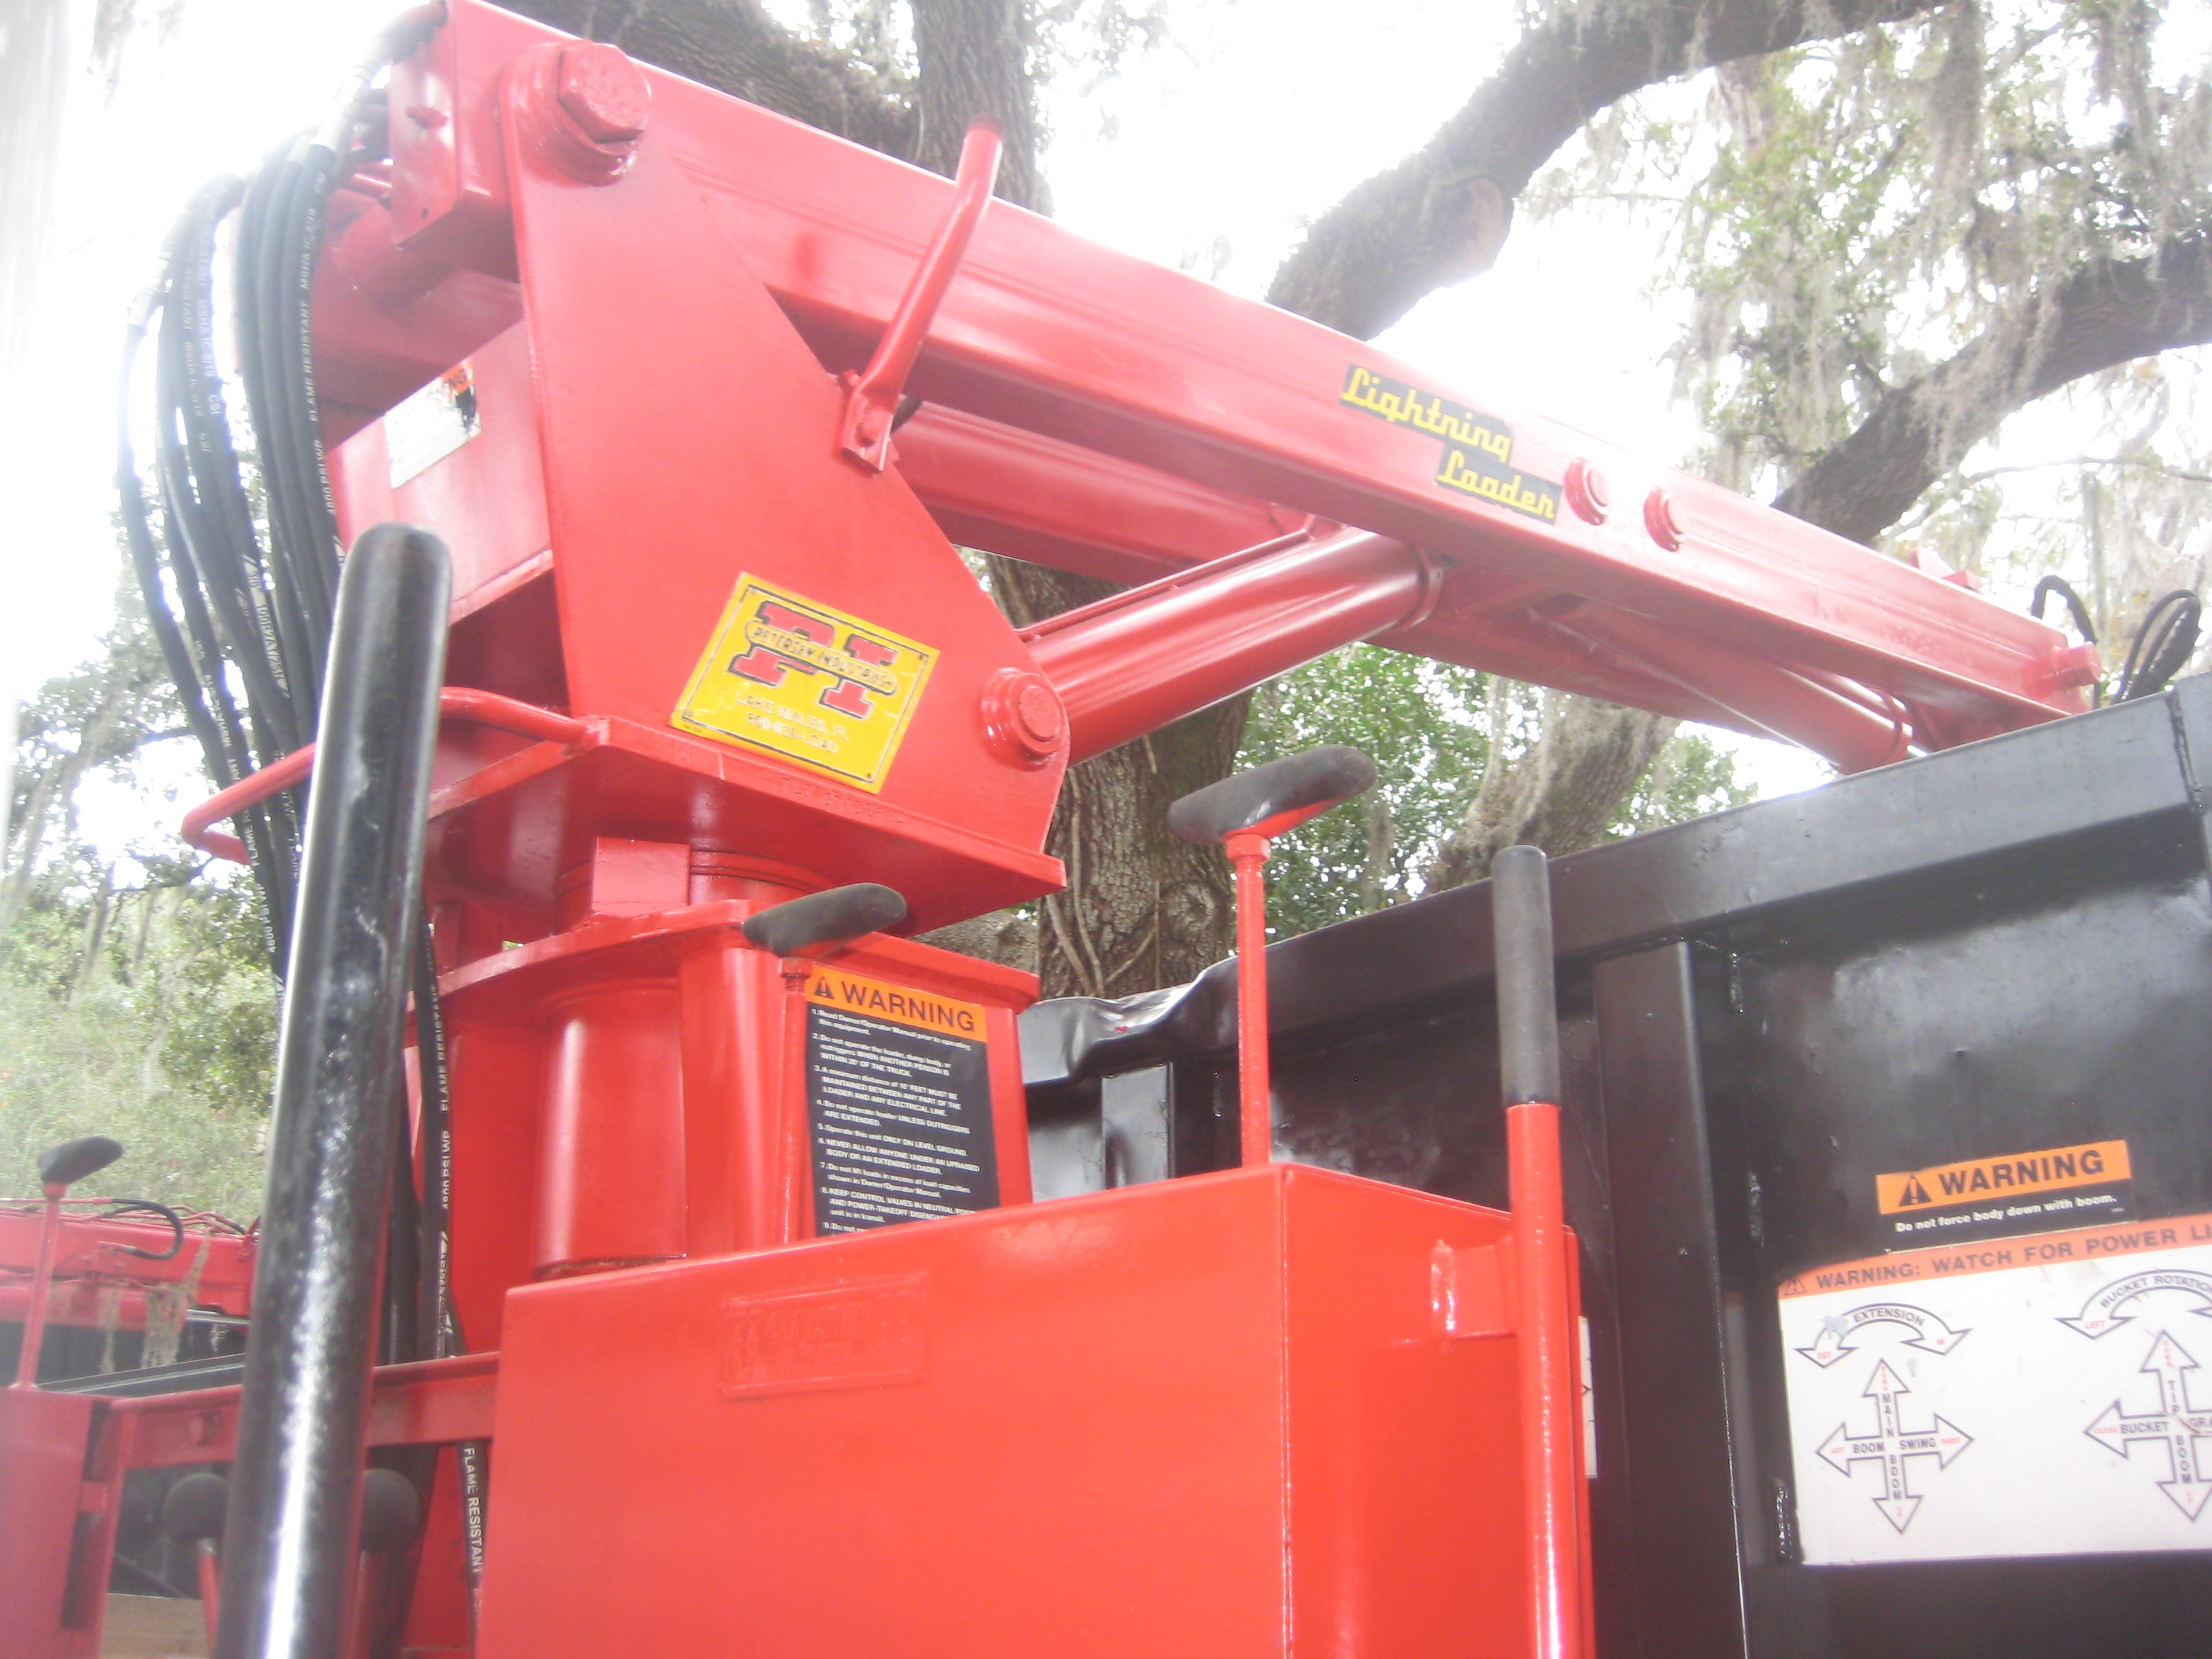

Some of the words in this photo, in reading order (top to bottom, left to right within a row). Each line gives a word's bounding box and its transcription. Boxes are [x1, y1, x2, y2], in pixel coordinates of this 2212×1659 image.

[305, 377, 318, 423] FLAME
[1340, 368, 1511, 464] Lightning
[1437, 450, 1555, 518] Loader
[753, 626, 814, 660] PETERSEN
[841, 981, 975, 1032] WARNING
[1938, 1150, 2105, 1196] WARNING
[1895, 1221, 1912, 1233] Do
[1915, 1218, 1937, 1230] not
[1938, 1213, 1972, 1227] force
[1972, 1209, 2005, 1222] body
[2006, 1204, 2042, 1216] down
[2044, 1200, 2073, 1212] with
[2074, 1194, 2118, 1208] boom.
[1816, 1263, 1921, 1290] WARNING:
[1932, 1250, 2013, 1274] WATCH
[2024, 1241, 2074, 1262] FOR
[2087, 1228, 2177, 1254] POWER
[2100, 1278, 2149, 1308] BUCKET
[2154, 1275, 2212, 1294] ROTATIO
[1853, 1308, 1925, 1326] EXTENSION
[2085, 1320, 2105, 1329] LEFT
[1853, 1441, 1885, 1454] BOOM
[1899, 1437, 1937, 1450] SWING
[1882, 1393, 1894, 1438] MAIN
[1890, 1455, 1902, 1501] BOOM
[2121, 1421, 2170, 1435] BUCKET
[463, 1447, 480, 1494] FLAME
[468, 1497, 484, 1573] RESISTANT
